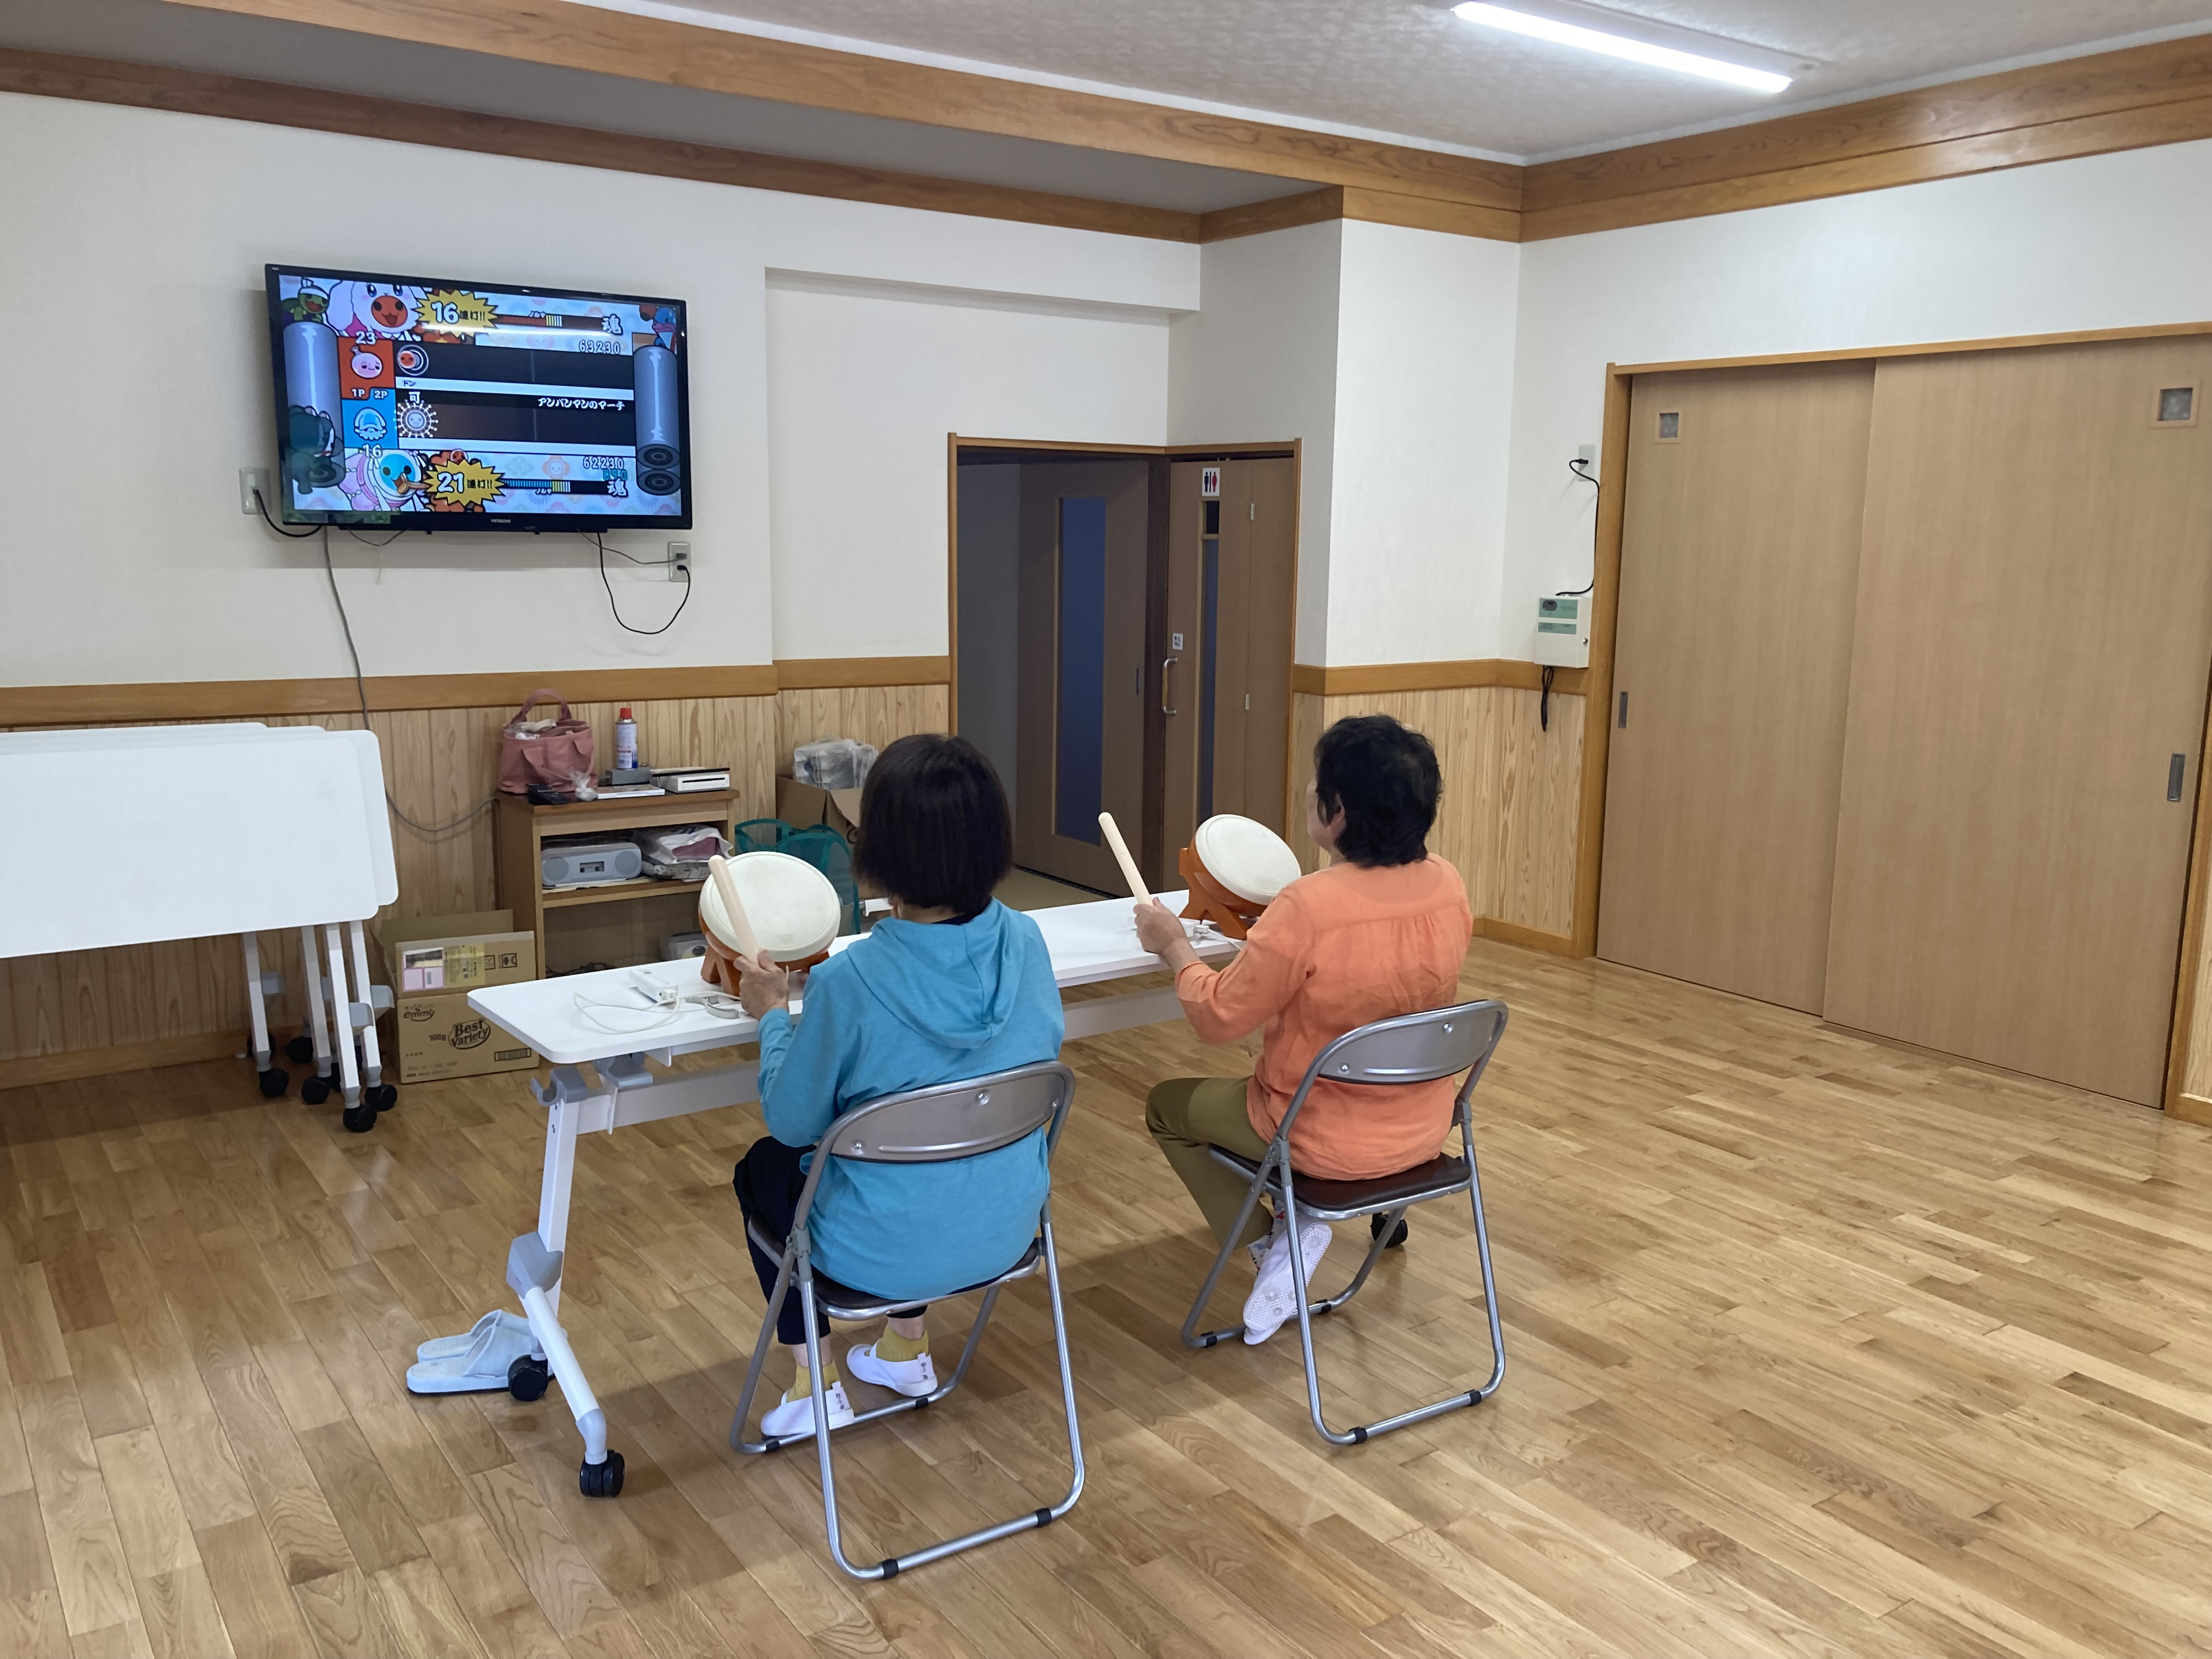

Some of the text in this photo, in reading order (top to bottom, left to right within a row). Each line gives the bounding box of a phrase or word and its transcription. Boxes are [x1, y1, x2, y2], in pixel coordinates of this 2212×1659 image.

[356, 331, 377, 345] 23
[579, 340, 620, 355] 63230
[352, 388, 365, 398] 1P
[374, 390, 388, 399] 2P
[362, 444, 383, 458] 16
[583, 456, 624, 470] 62230
[454, 1019, 483, 1037] Best
[451, 1027, 489, 1048] Variety
